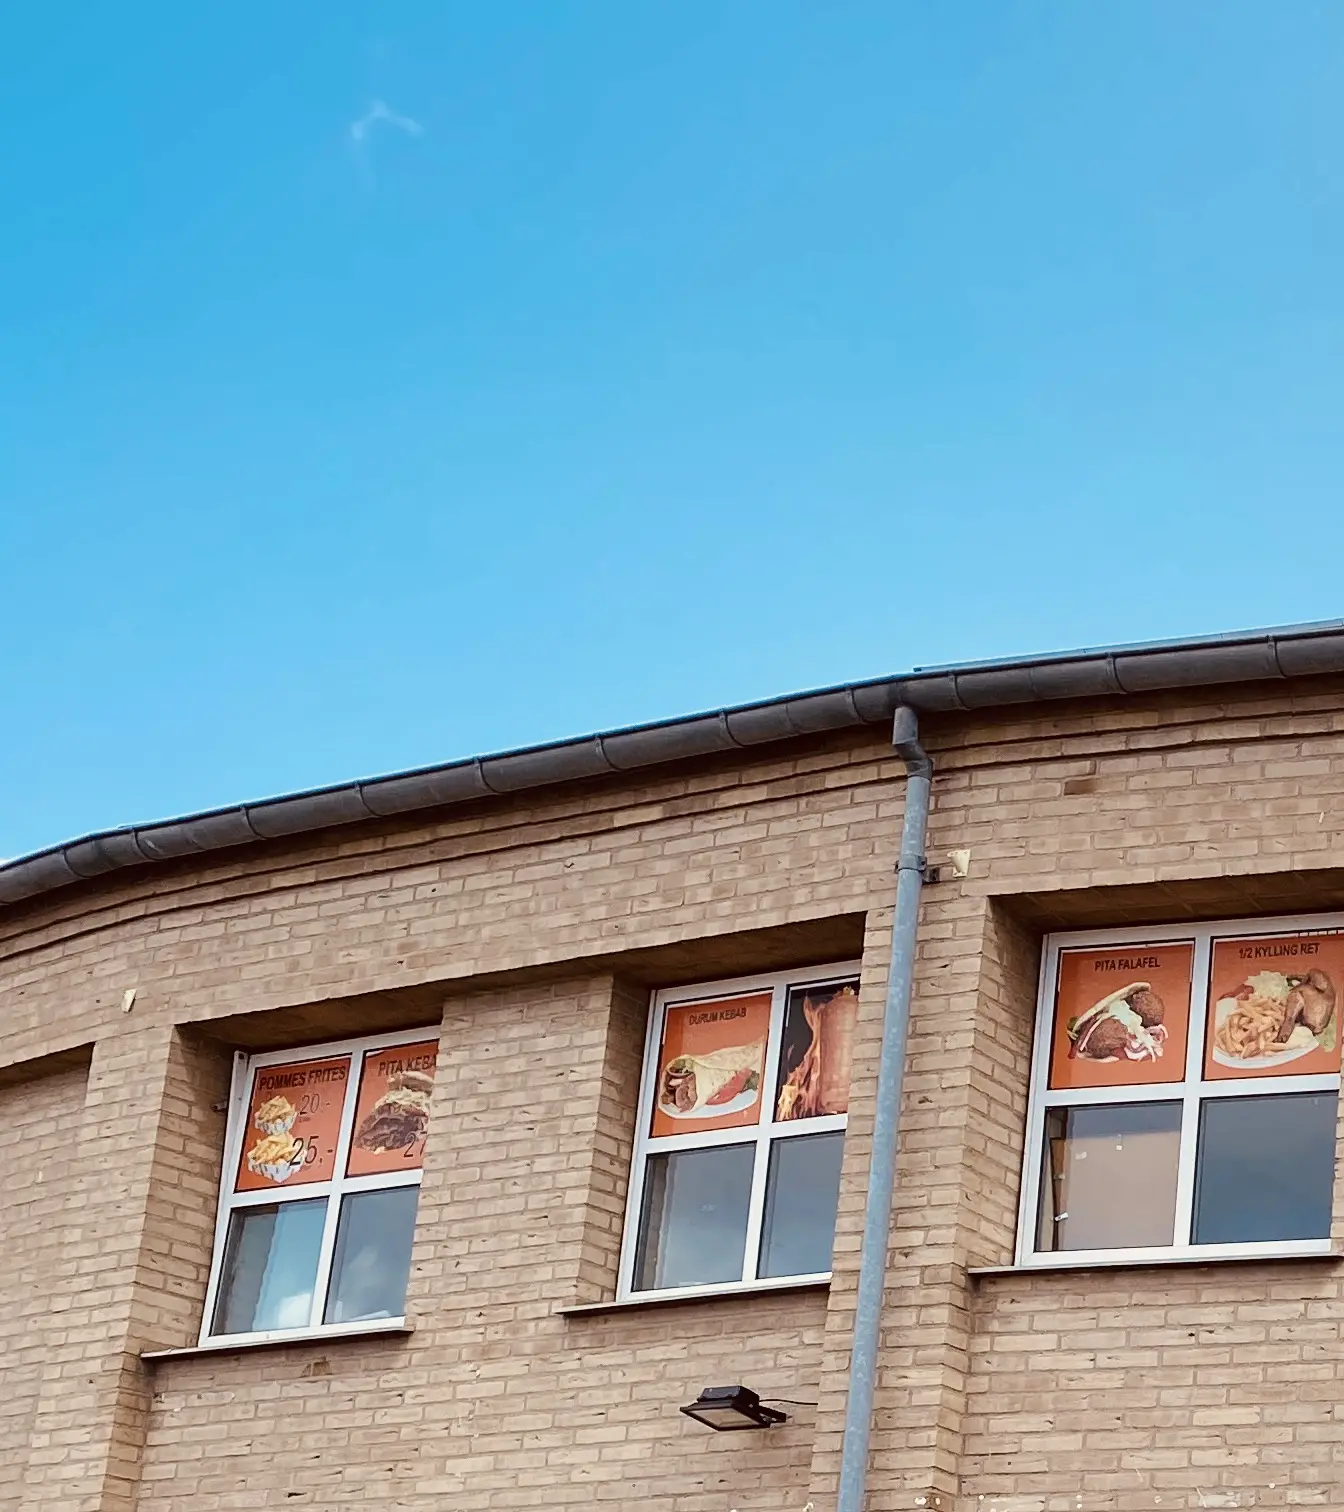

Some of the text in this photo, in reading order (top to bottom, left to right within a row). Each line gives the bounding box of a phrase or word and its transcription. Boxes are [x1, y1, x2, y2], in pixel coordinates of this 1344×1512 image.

[1255, 944, 1299, 958] KYLLING
[1300, 942, 1320, 955] RET
[1094, 956, 1160, 971] PITA FALAFEL
[689, 1007, 747, 1026] DURUM KEBAB
[378, 1054, 437, 1077] PITA KEBA
[258, 1066, 346, 1091] POMMES FRITES
